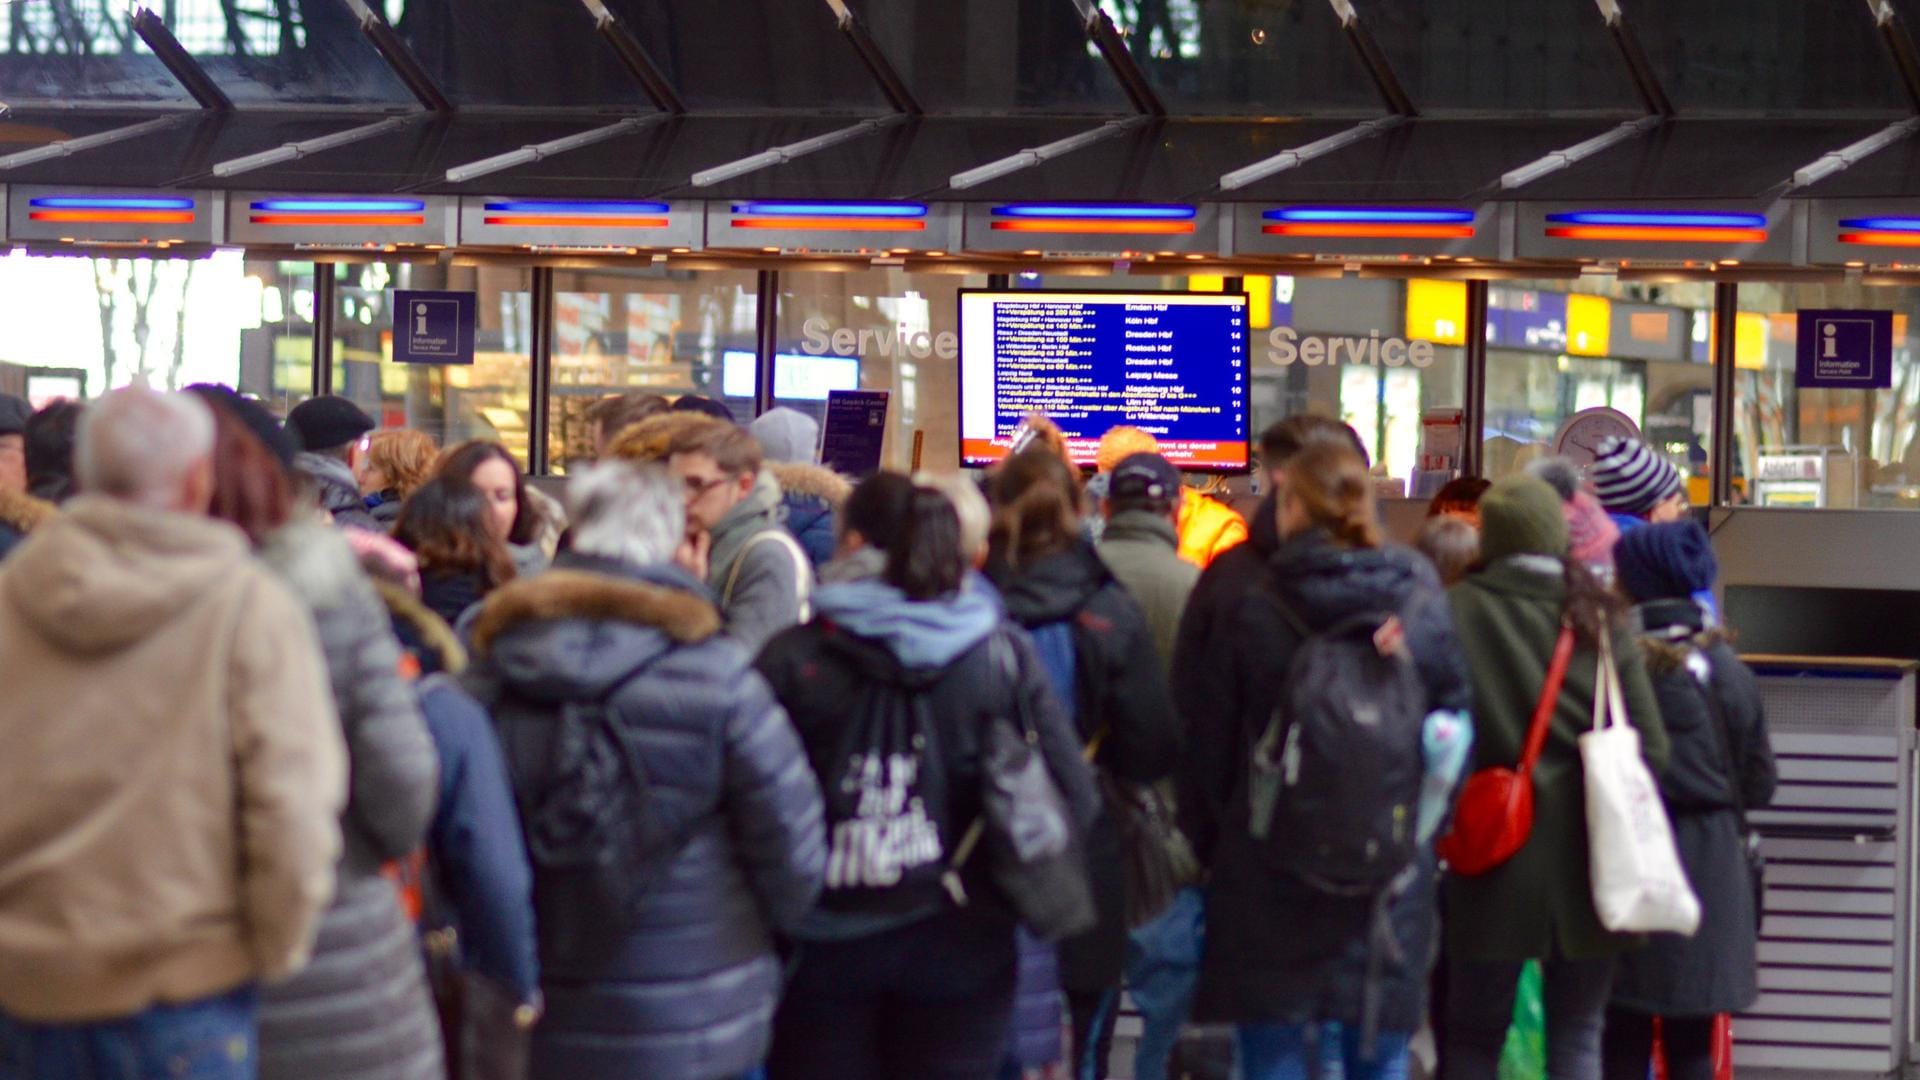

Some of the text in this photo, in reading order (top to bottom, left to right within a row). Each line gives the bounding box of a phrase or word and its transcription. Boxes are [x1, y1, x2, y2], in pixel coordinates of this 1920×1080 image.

[1125, 317, 1143, 325] Köln
[1125, 330, 1157, 338] Dresden
[412, 337, 447, 345] Information
[802, 318, 958, 359] Service
[1125, 344, 1156, 352] Rostock
[1268, 326, 1435, 367] Service
[1125, 358, 1173, 366] Dresden Hbf
[1819, 360, 1860, 369] Information
[1125, 372, 1179, 380] Leipzig Messe
[1125, 385, 1184, 395] Magdeburg Hbf
[1231, 400, 1241, 408] 11
[1137, 413, 1179, 422] Wittenberg
